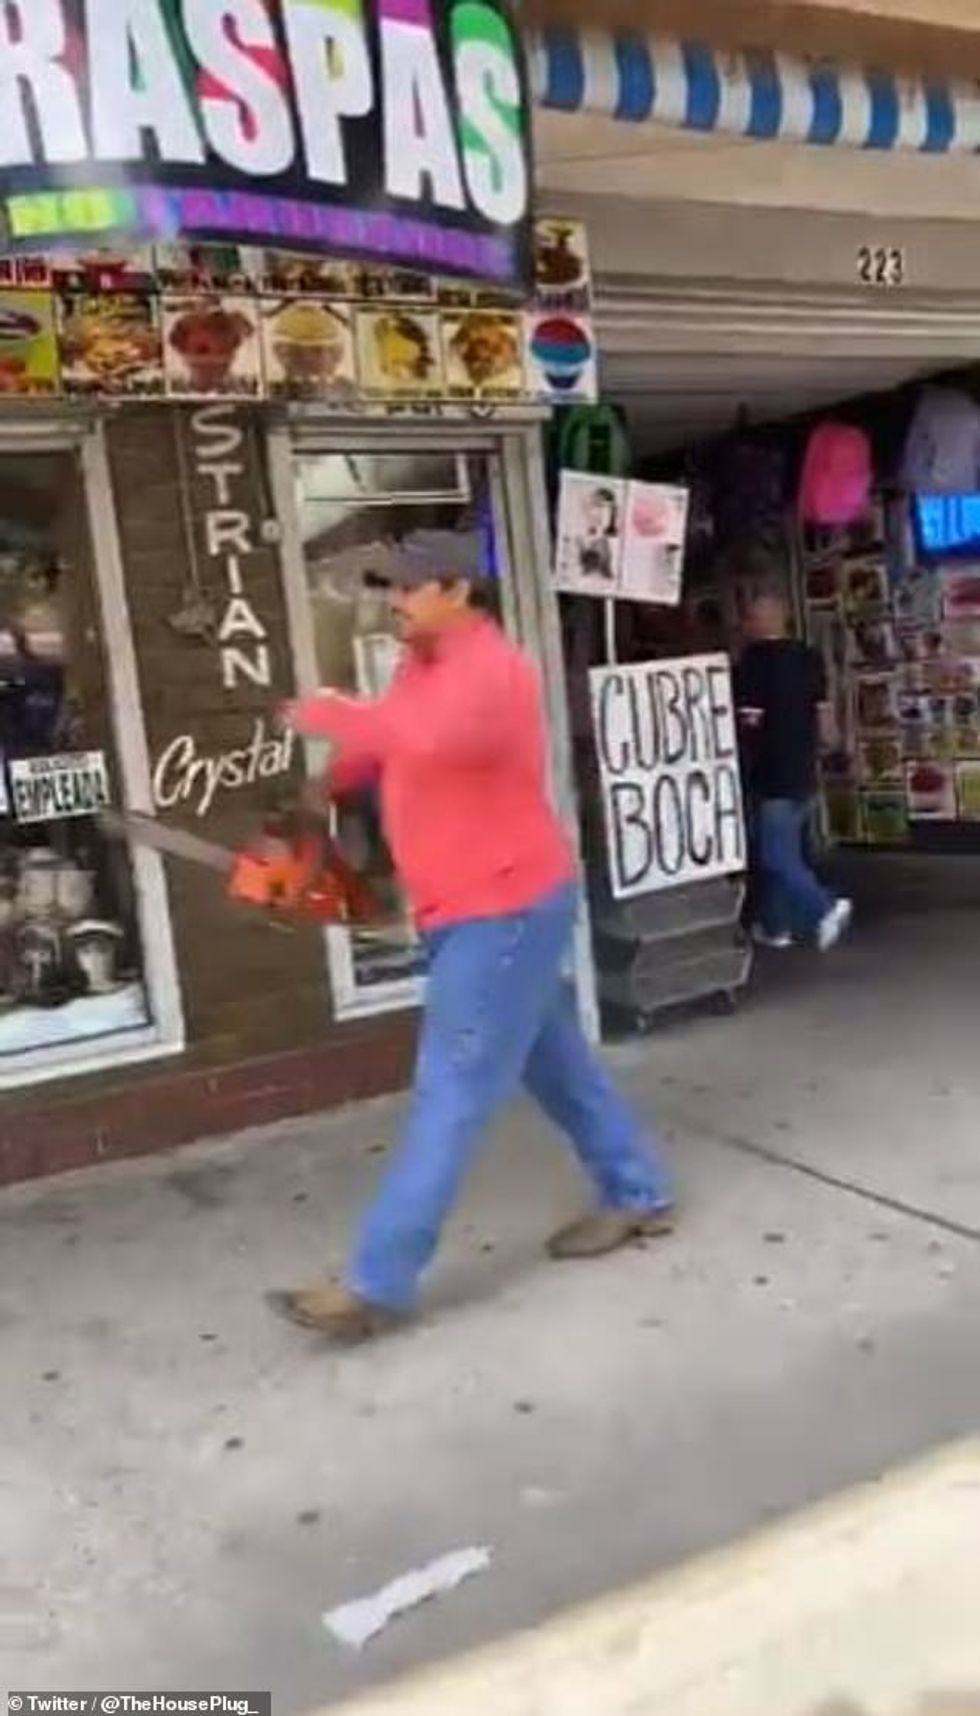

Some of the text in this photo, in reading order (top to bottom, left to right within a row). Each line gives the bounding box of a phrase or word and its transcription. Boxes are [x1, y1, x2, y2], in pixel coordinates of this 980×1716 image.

[0, 0, 528, 225] RASPAS
[857, 246, 903, 283] 223
[153, 717, 294, 817] Crystal
[599, 664, 734, 776] CUBRE
[610, 764, 741, 889] BOCA
